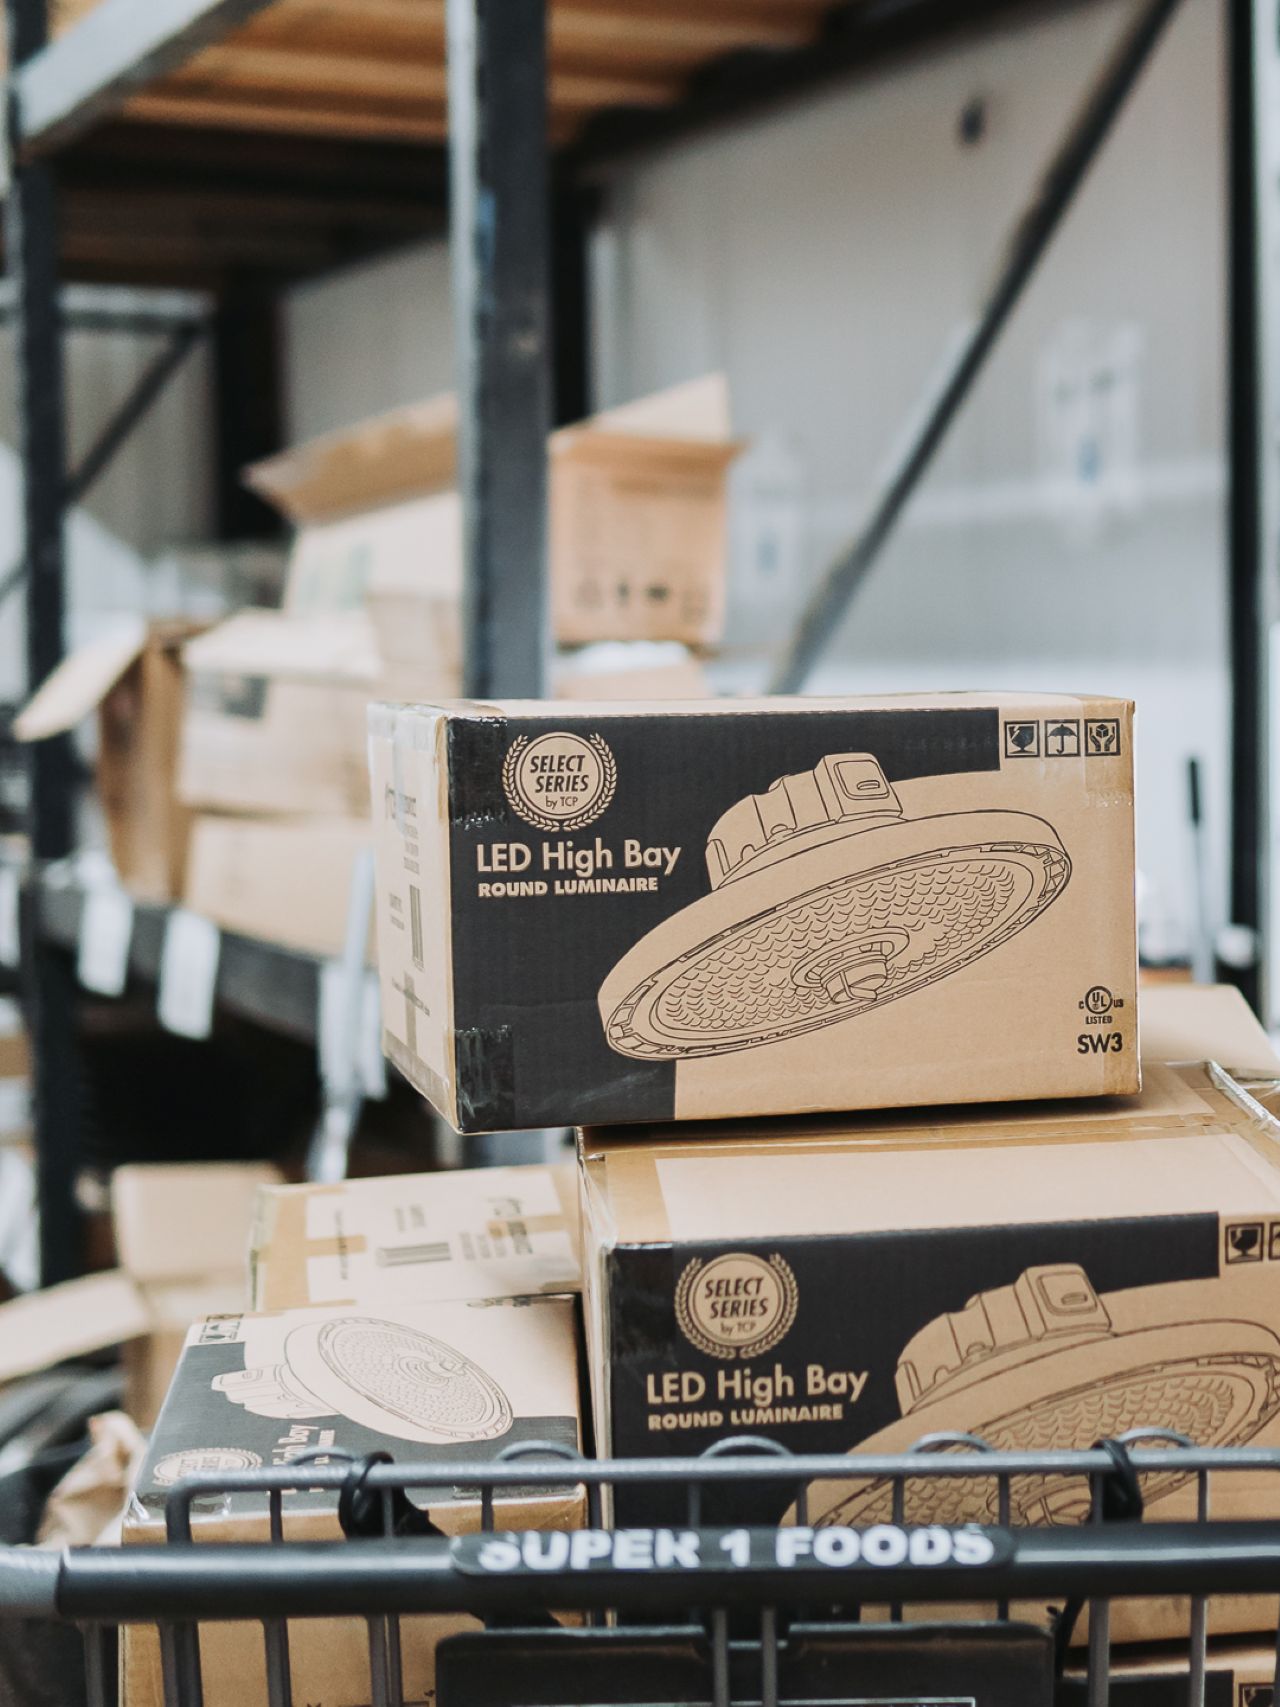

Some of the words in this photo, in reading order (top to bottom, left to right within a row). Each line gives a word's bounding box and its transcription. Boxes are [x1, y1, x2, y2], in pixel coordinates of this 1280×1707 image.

[530, 754, 586, 773] SELECT
[535, 774, 589, 793] SERIES
[545, 796, 558, 809] by
[559, 796, 579, 807] TCP
[476, 842, 532, 873] LED
[541, 837, 613, 877] High
[624, 839, 682, 876] Bay
[478, 881, 549, 898] ROUND
[554, 876, 659, 896] LUMINAIRE
[1085, 1015, 1113, 1025] LISTED
[1077, 1031, 1123, 1054] SW3
[704, 1276, 764, 1299] SELECT
[710, 1298, 769, 1319] SERIES
[646, 1371, 706, 1405] LED
[717, 1363, 795, 1408] High
[806, 1363, 869, 1402] Bay
[648, 1411, 724, 1431] ROUND
[730, 1403, 843, 1426] LUMINAIRE
[478, 1527, 701, 1572] SUPER
[719, 1529, 751, 1568] 1
[775, 1524, 995, 1568] FOODS
